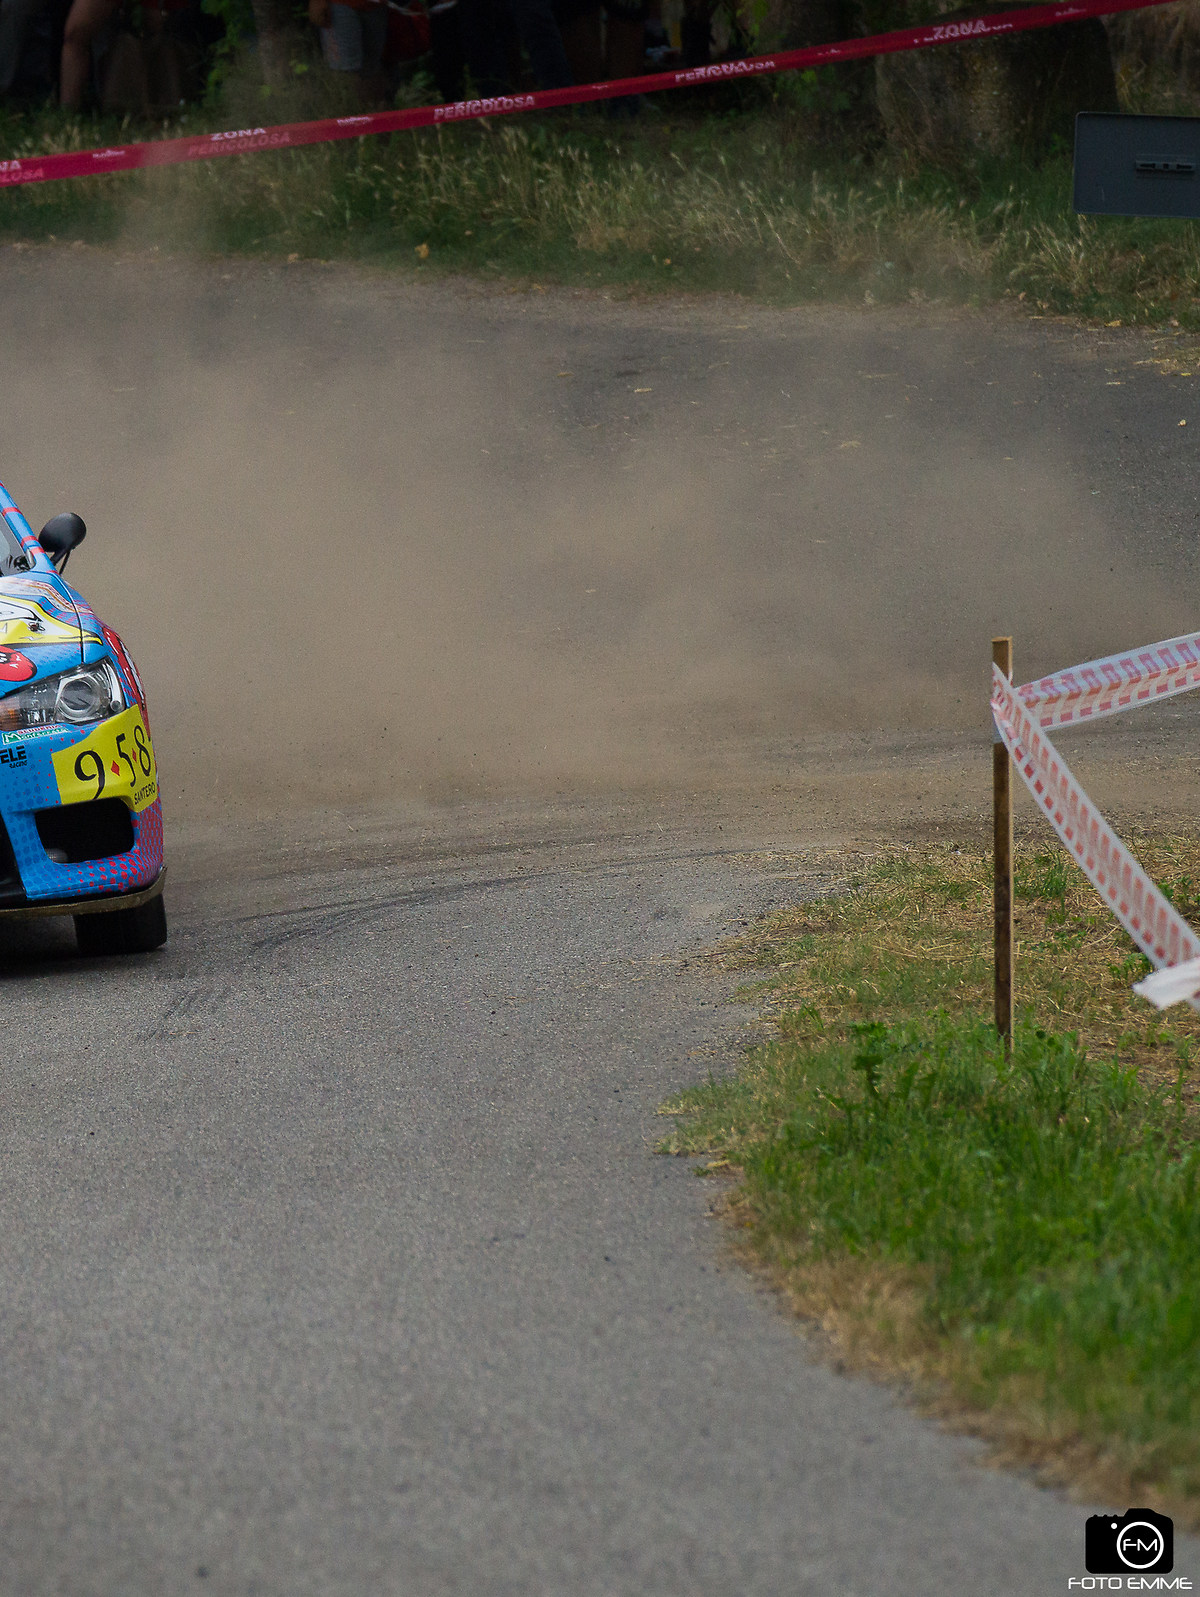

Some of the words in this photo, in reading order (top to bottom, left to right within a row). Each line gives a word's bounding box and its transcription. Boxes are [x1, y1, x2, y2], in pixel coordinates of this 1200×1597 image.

[433, 95, 536, 121] PERICOLOSA
[187, 131, 291, 157] PERICOLOSA
[210, 127, 267, 141] ZONA
[133, 782, 156, 805] SANTERO
